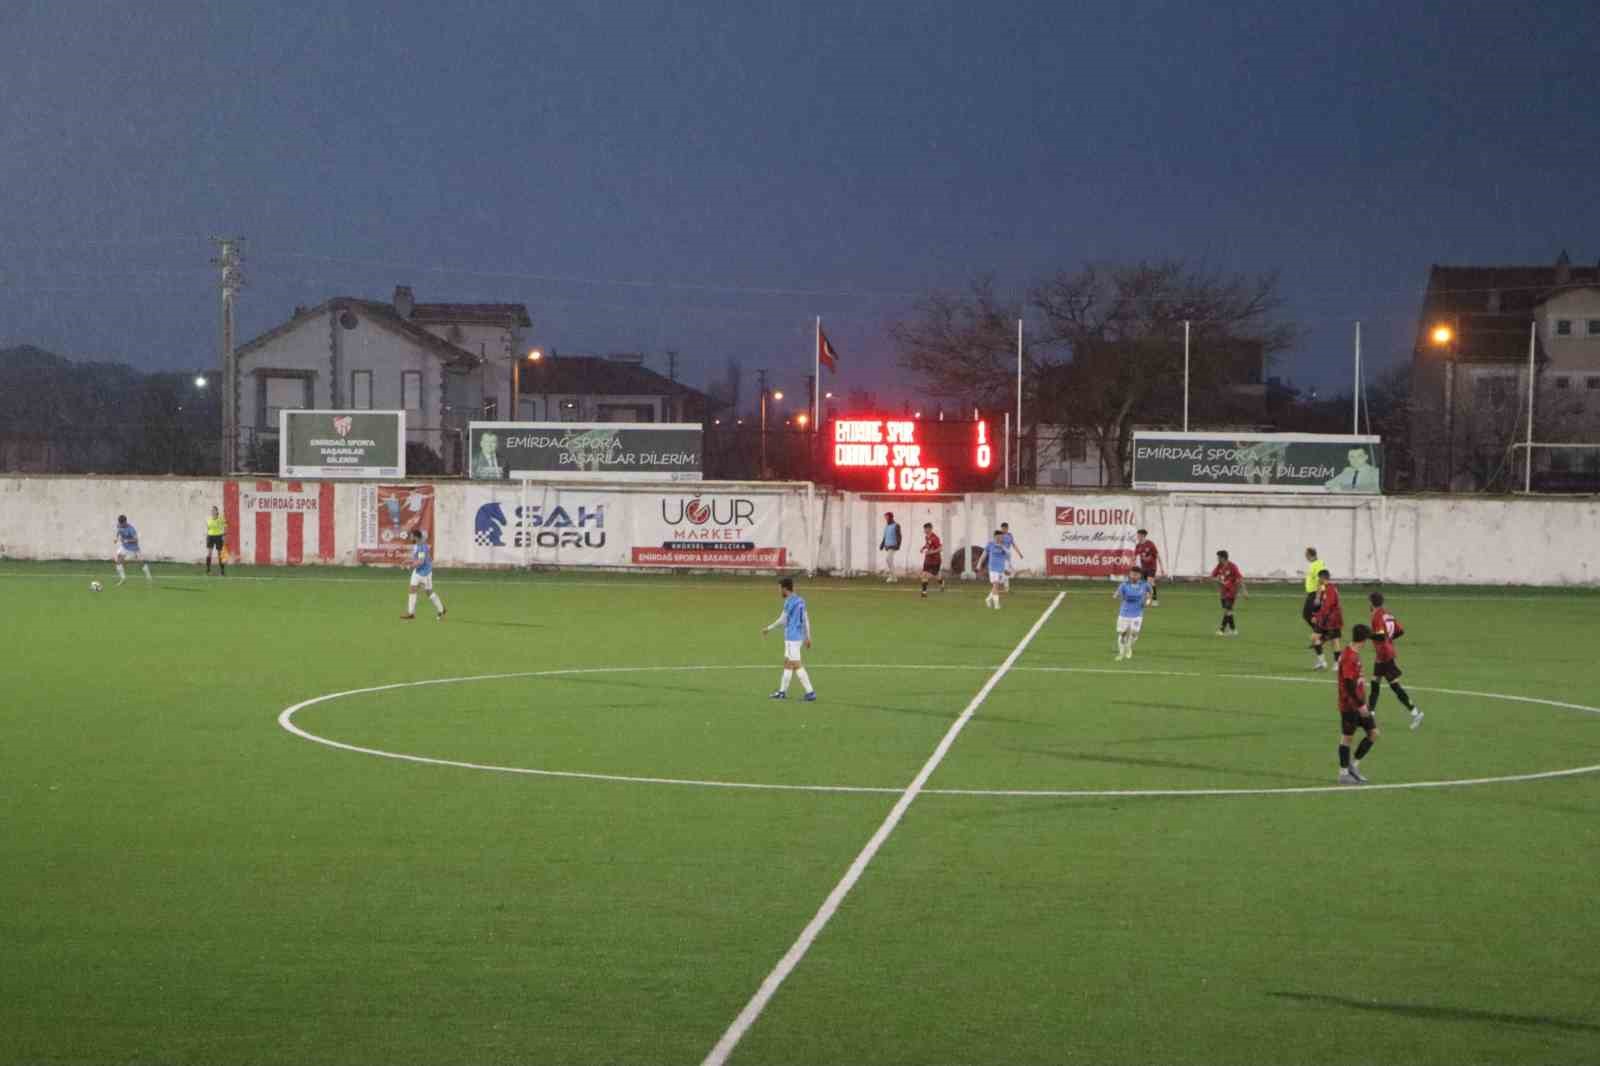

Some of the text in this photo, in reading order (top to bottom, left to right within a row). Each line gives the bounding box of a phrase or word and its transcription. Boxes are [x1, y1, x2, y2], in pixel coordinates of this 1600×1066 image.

[977, 421, 986, 443] 1
[977, 446, 990, 468] 0
[1191, 464, 1272, 479] BAŞARILAR
[295, 498, 317, 510] SPOR
[662, 494, 754, 525] UĞUR
[514, 531, 606, 548] BORU
[674, 528, 744, 539] MARKET
